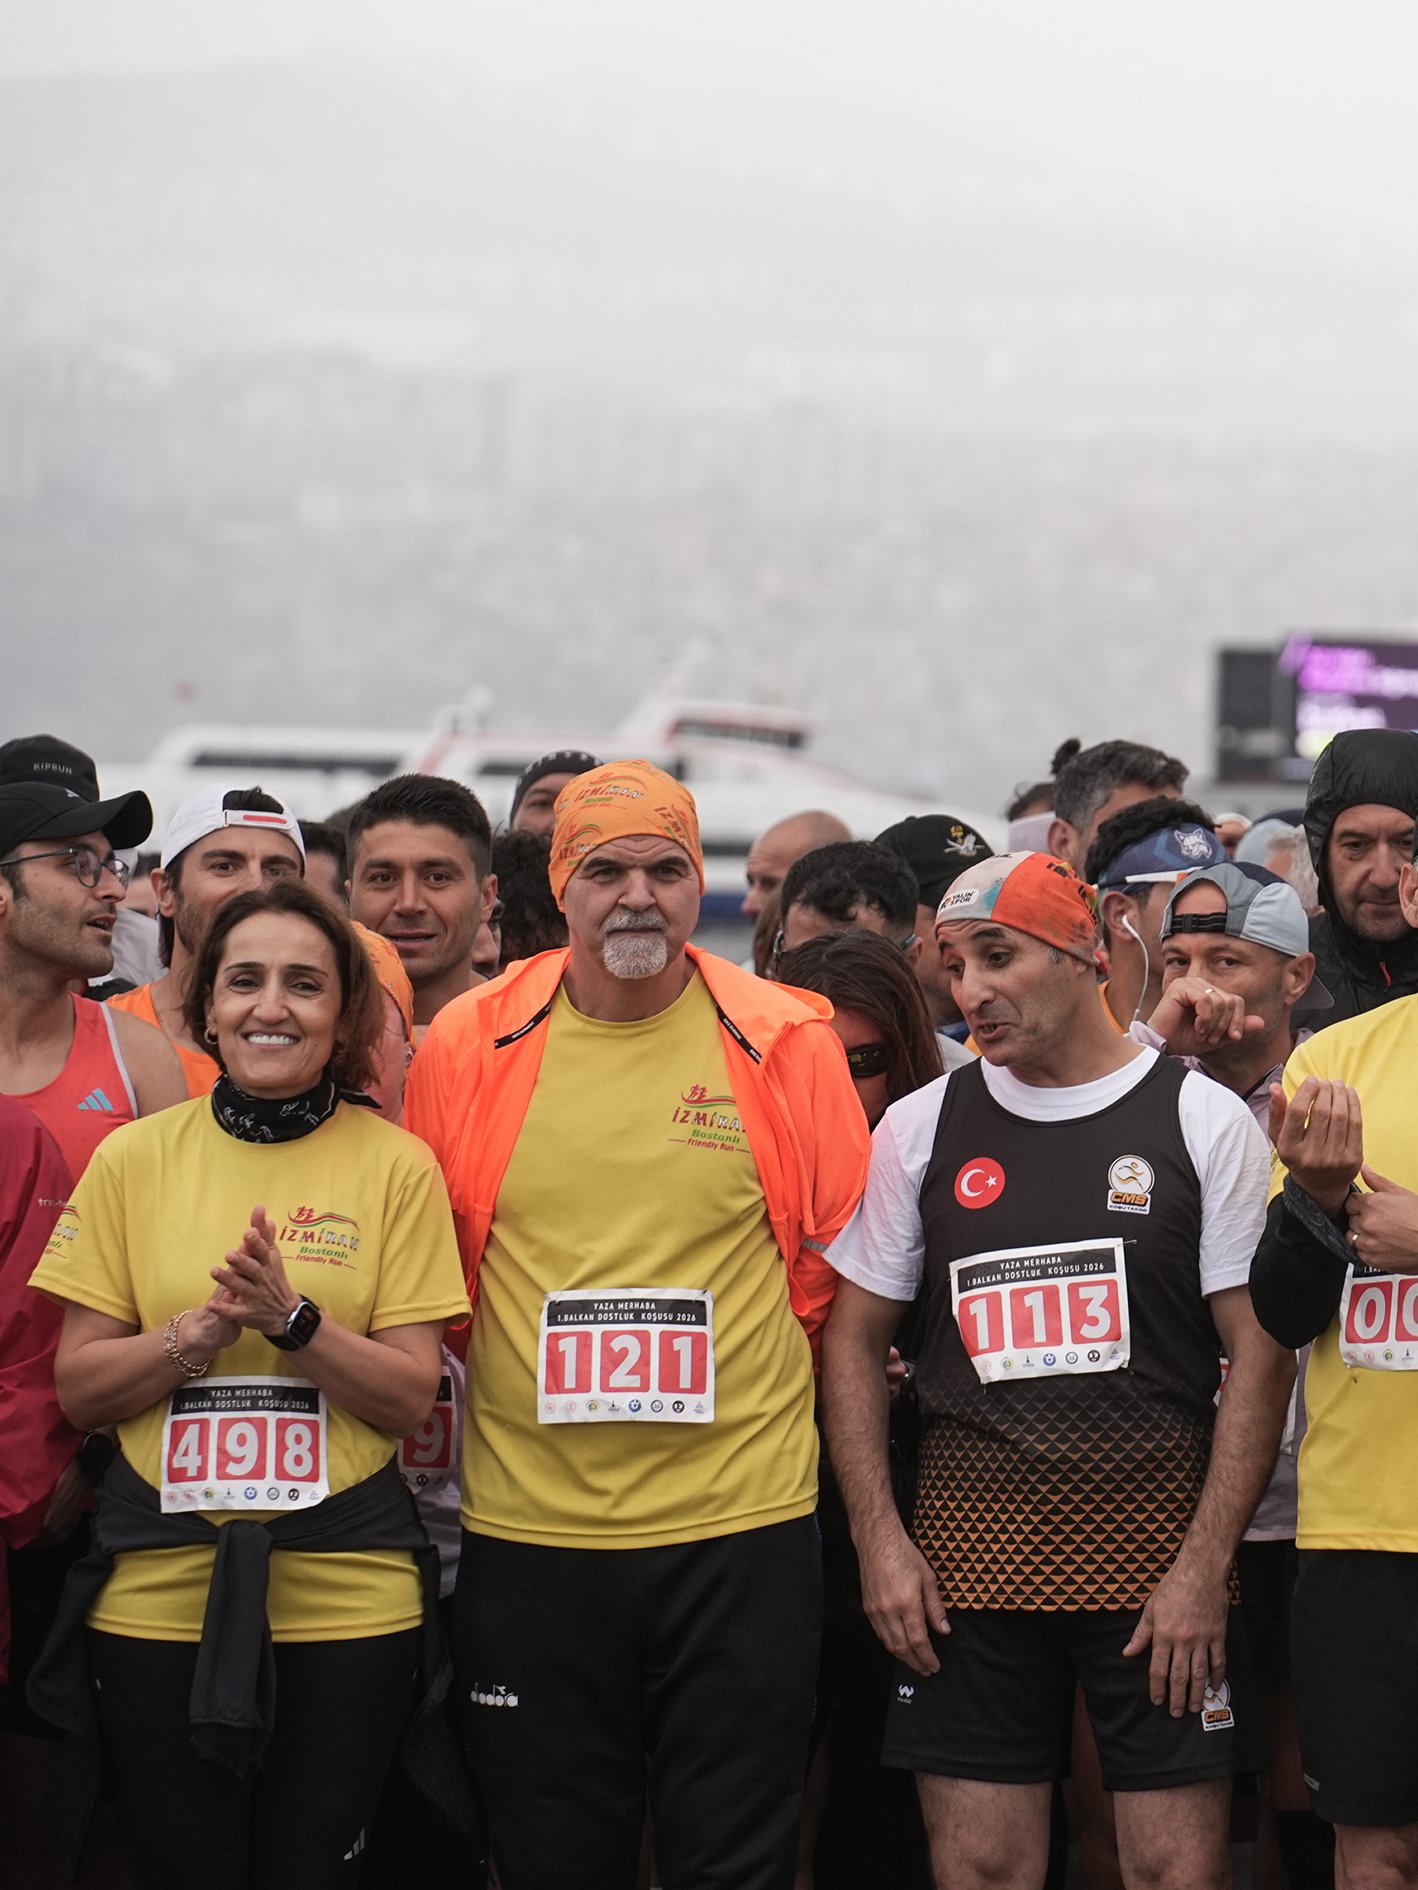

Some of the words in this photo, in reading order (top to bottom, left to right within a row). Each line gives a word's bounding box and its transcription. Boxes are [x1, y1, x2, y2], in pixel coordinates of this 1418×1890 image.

[33, 762, 72, 775] KIPRUN
[672, 1107, 746, 1133] İZMİRA
[688, 1138, 718, 1150] Friendly
[720, 1143, 734, 1151] Run
[1111, 1192, 1148, 1206] CMS
[296, 1254, 326, 1264] Friendly
[329, 1258, 343, 1266] Run
[1000, 1261, 1021, 1271] YAZA
[1024, 1256, 1062, 1267] MERHABA
[1005, 1267, 1041, 1280] DOSTLUK
[1048, 1265, 1080, 1276] KOŞUSU
[1083, 1263, 1105, 1272] 2026
[594, 1302, 614, 1310] YAZA
[618, 1302, 656, 1310] MERHABA
[598, 1312, 635, 1321] DOSTLUK
[641, 1312, 673, 1322] KOŞUSU
[676, 1313, 696, 1321] 2026
[969, 1285, 1111, 1350] 113
[558, 1334, 692, 1389] 121
[211, 1389, 232, 1397] YAZA
[235, 1388, 273, 1396] MERHABA
[215, 1400, 251, 1408] DOSTLUK
[291, 1401, 310, 1409] 2026
[172, 1421, 313, 1477] 498
